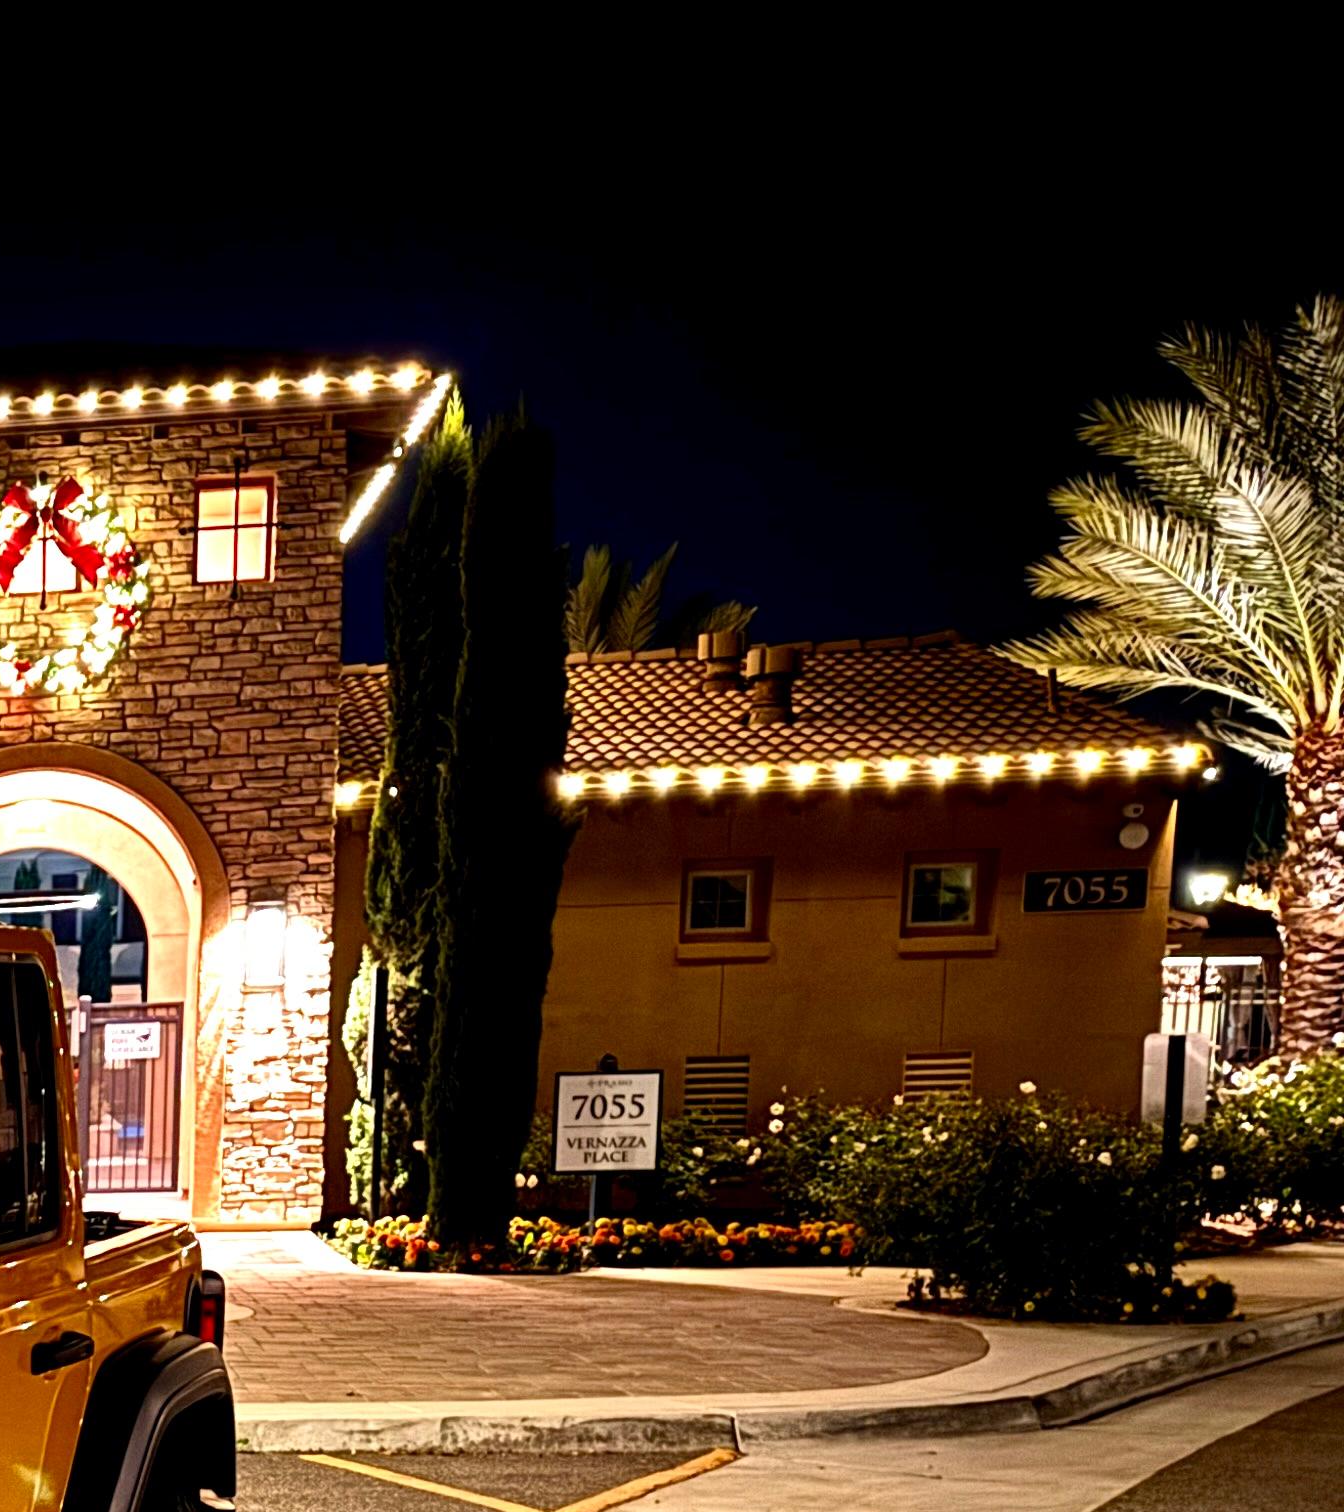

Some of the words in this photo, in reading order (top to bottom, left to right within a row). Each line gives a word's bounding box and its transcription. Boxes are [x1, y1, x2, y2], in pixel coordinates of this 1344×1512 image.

[1044, 875, 1129, 907] 7055
[572, 1094, 645, 1120] 7055
[567, 1136, 647, 1150] VERNAZZA
[583, 1151, 629, 1164] PLACE
